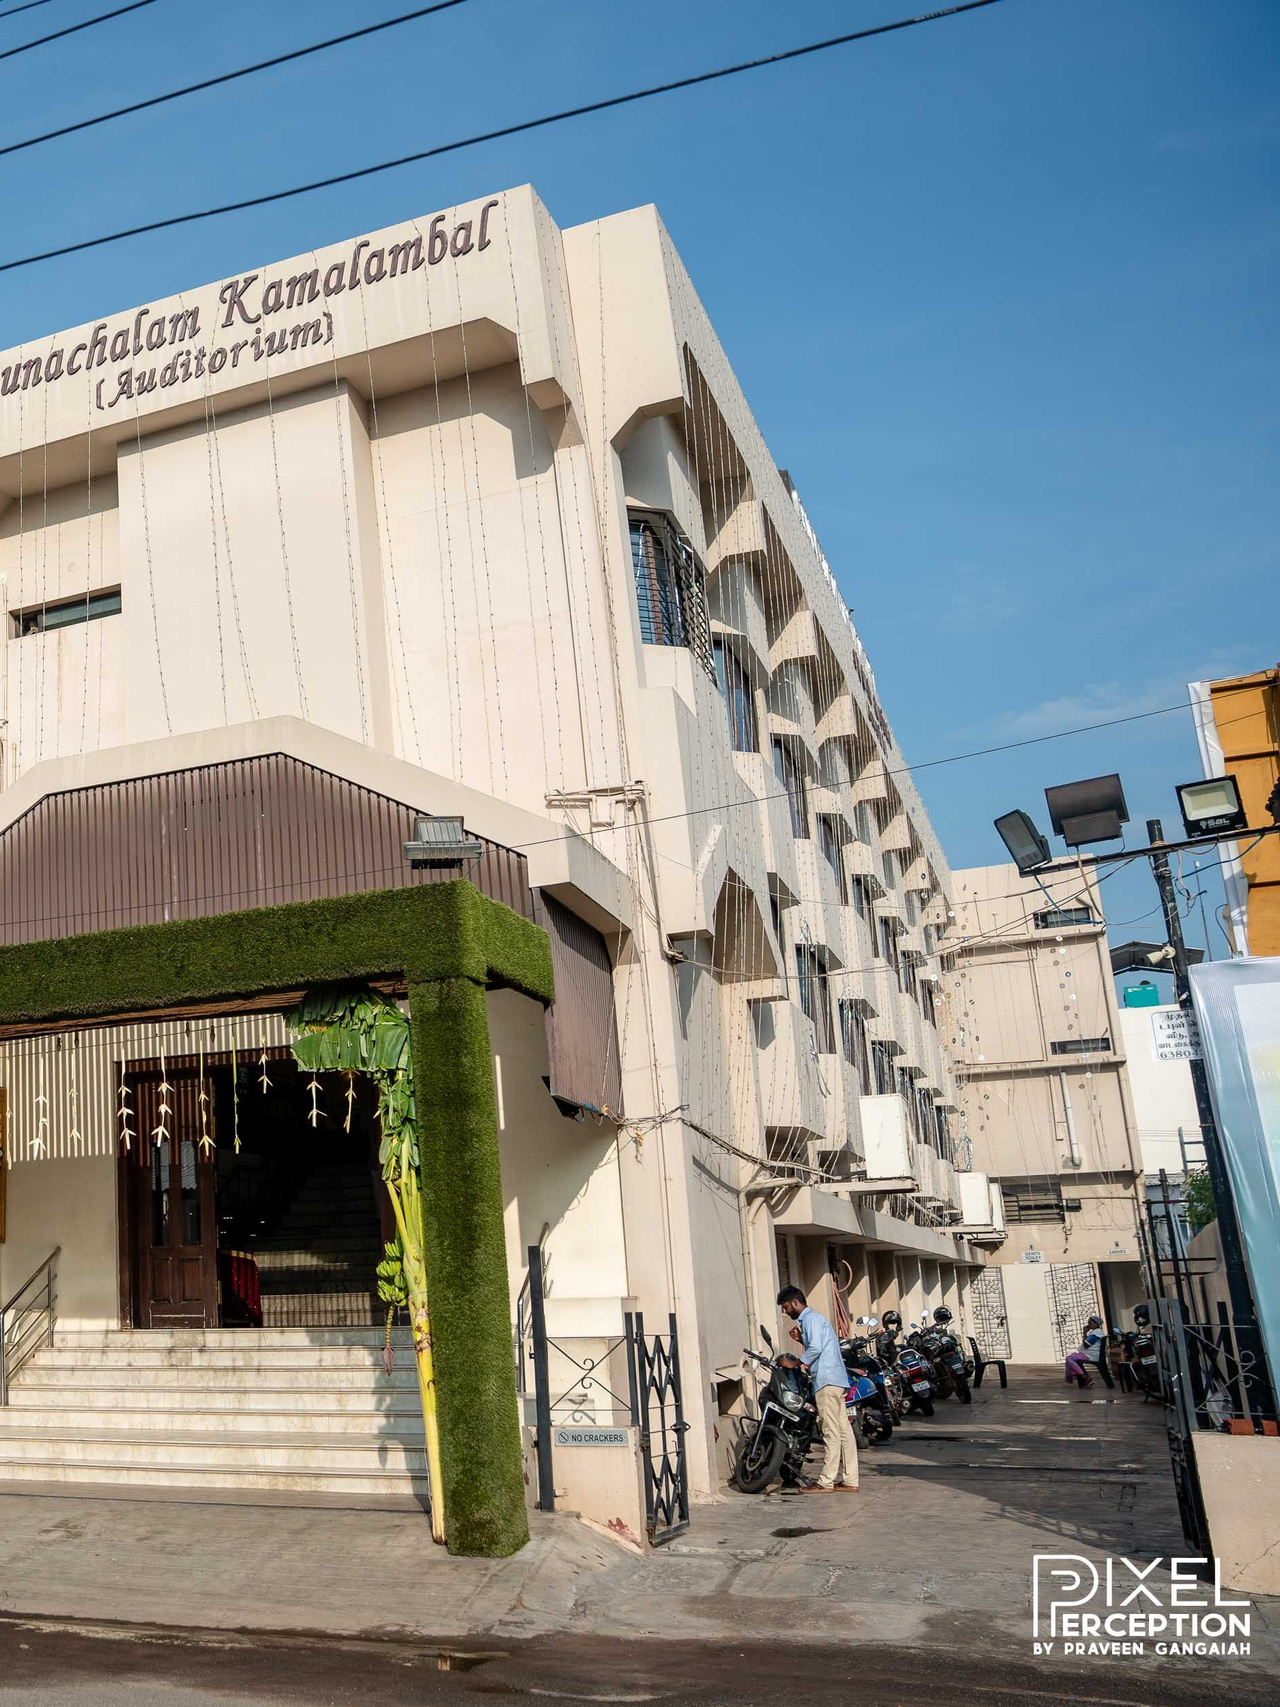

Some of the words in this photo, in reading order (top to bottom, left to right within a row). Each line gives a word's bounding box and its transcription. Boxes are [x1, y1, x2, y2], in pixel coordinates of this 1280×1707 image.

[219, 199, 499, 328] Kamalambal
[572, 1434, 583, 1442] NO
[584, 1434, 624, 1442] CRACKERS
